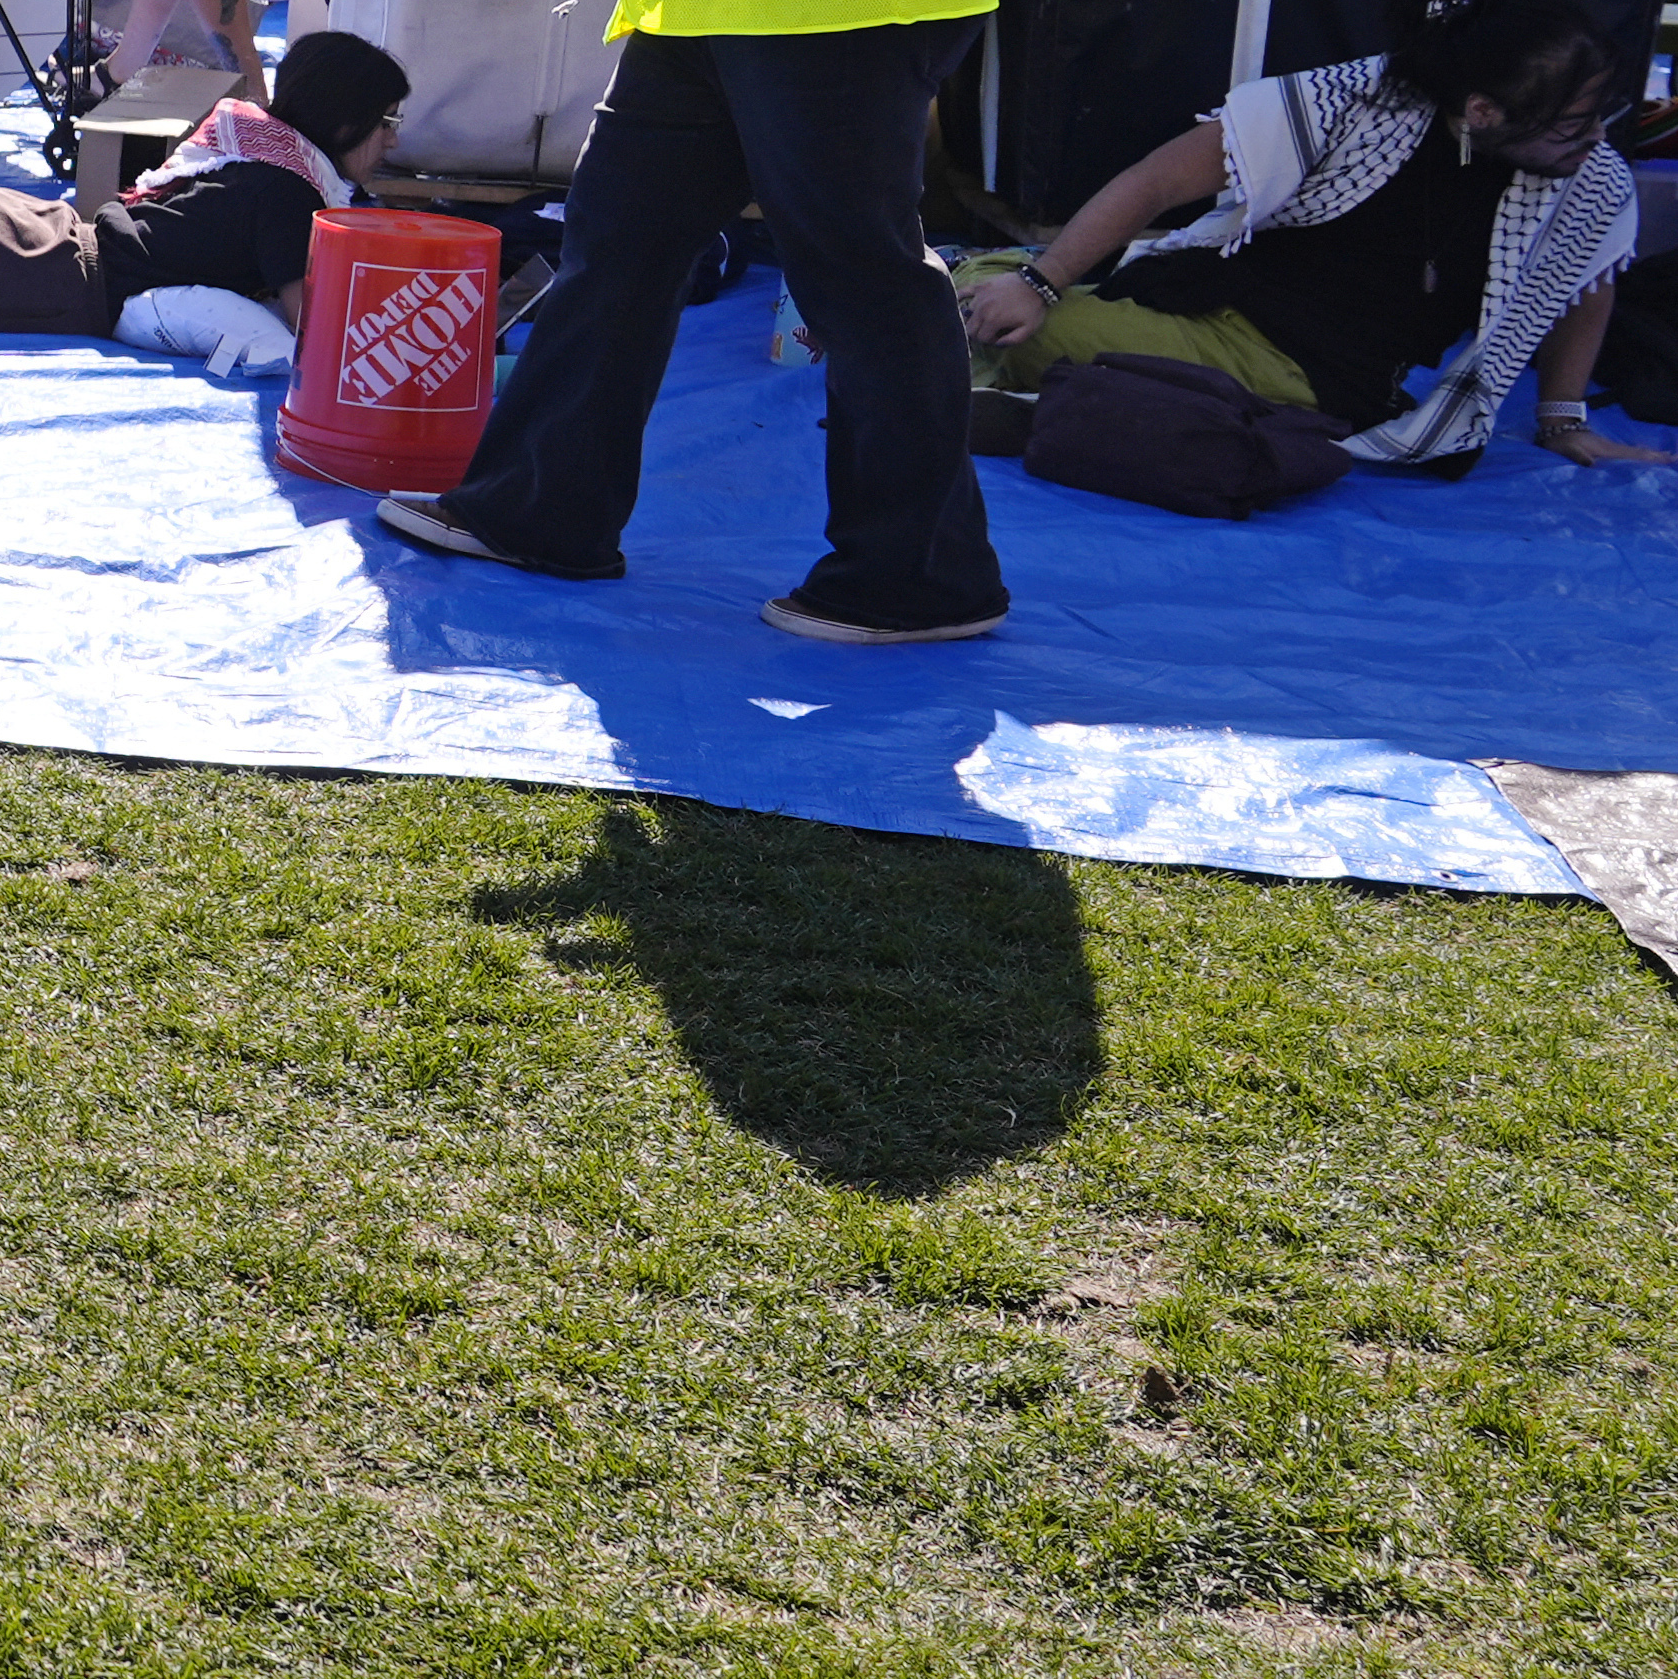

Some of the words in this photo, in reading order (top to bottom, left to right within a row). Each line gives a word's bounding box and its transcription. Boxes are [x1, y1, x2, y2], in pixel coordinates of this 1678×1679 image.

[342, 272, 484, 405] HOME
[348, 271, 440, 353] DEPOT
[413, 340, 471, 396] THE
